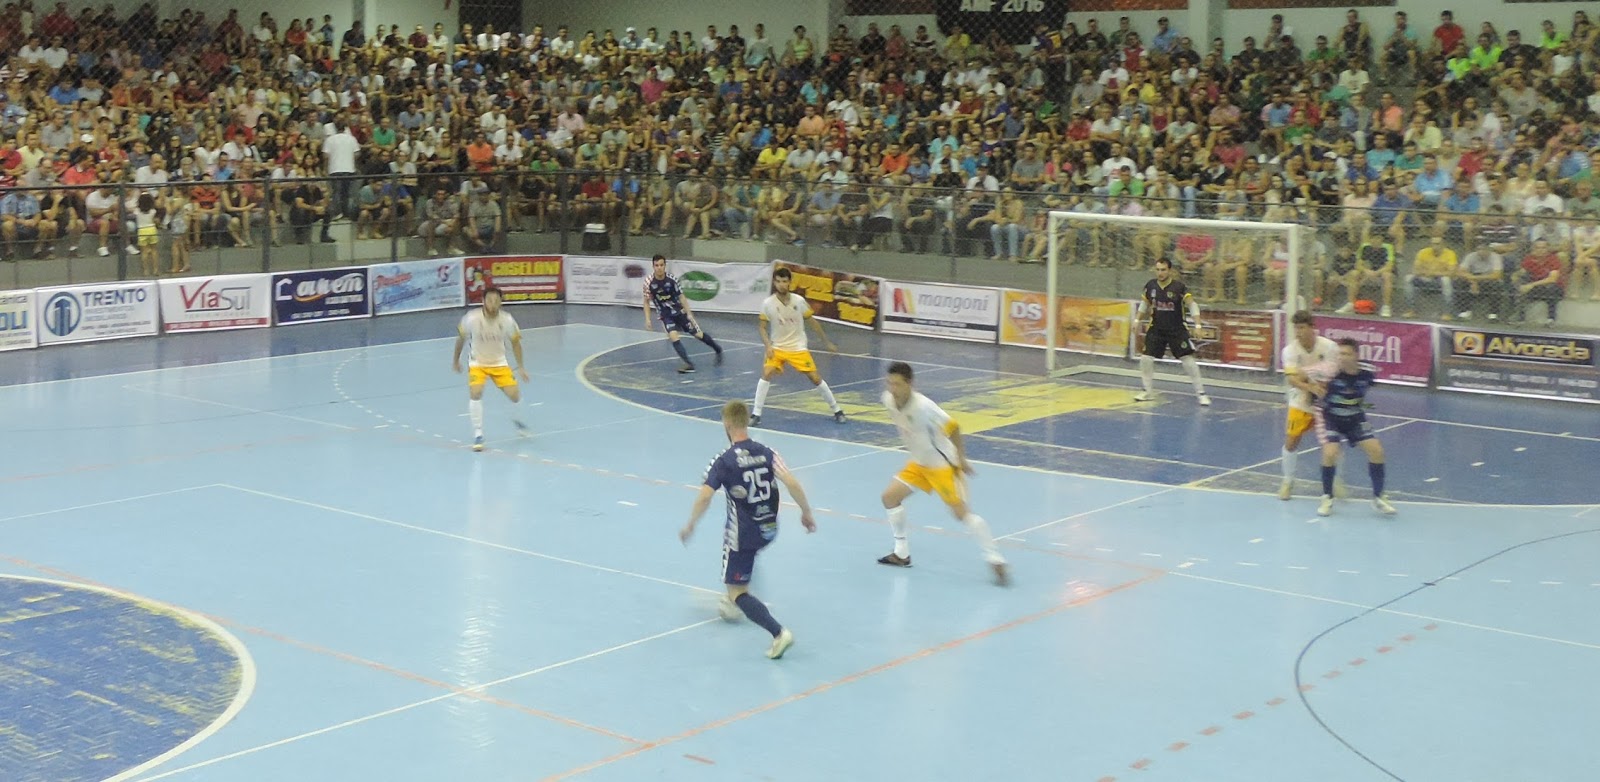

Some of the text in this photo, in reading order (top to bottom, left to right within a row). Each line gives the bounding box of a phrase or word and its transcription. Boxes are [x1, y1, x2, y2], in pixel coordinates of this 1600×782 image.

[83, 288, 147, 307] TRENTO
[918, 293, 990, 314] mangoni
[1010, 301, 1043, 321] DS
[1486, 336, 1591, 361] Alvorada
[743, 467, 771, 504] 25
